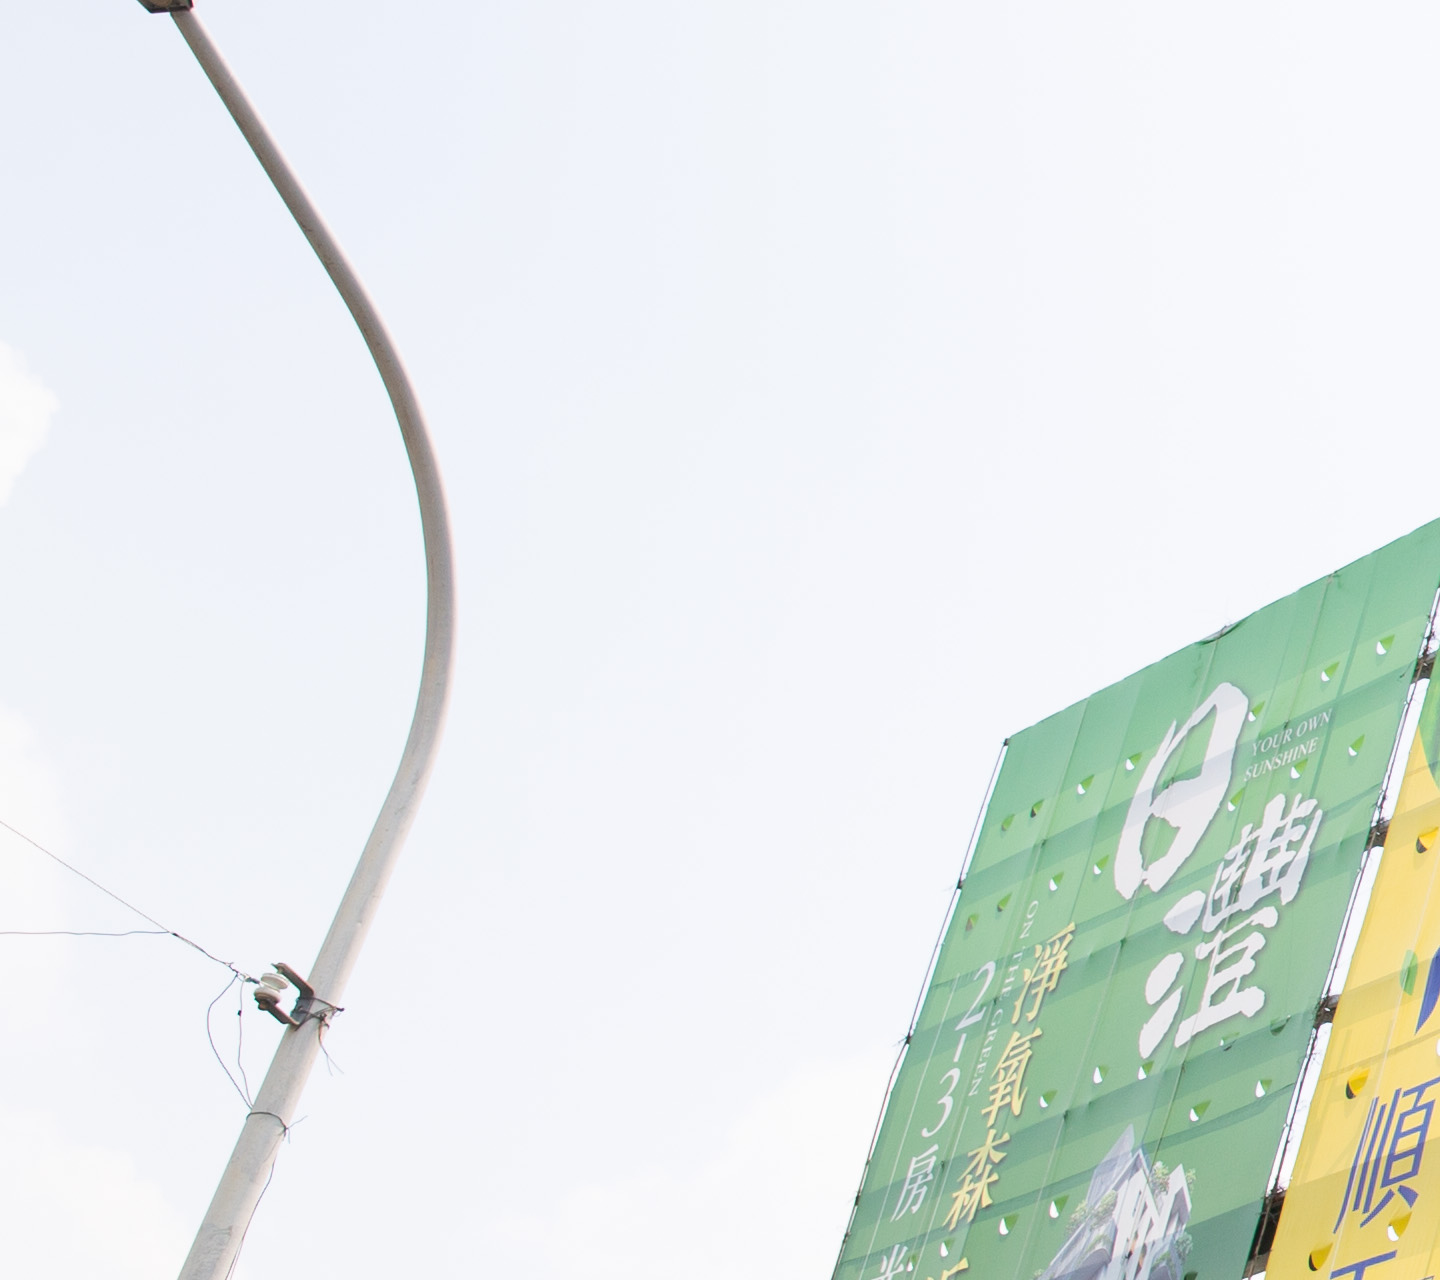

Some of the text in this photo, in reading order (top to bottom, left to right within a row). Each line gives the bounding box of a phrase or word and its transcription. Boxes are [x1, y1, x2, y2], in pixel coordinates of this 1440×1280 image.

[1251, 708, 1333, 757] YOUR OWN
[1244, 736, 1319, 782] SUNSHINE
[967, 899, 1040, 1098] ON THE GREEN
